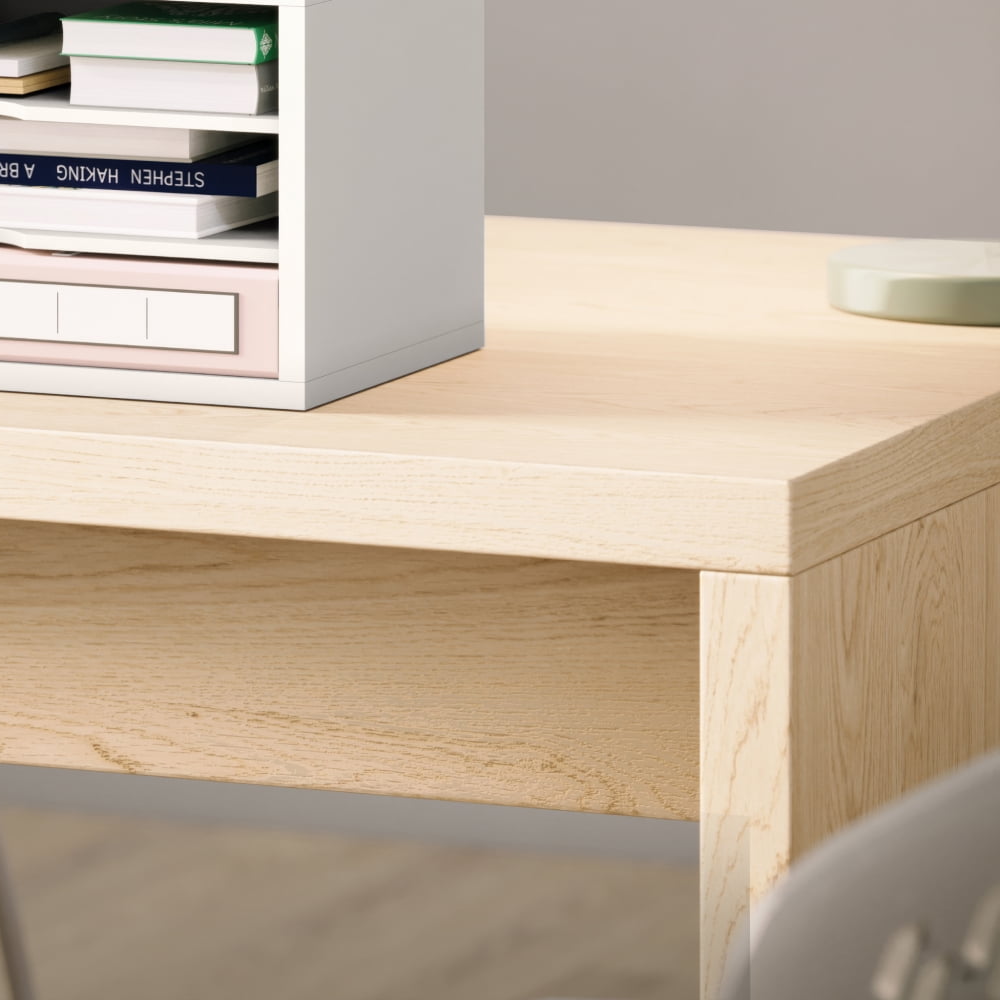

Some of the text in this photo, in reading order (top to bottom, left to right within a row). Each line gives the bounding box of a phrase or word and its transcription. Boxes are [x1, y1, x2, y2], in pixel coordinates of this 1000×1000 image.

[24, 163, 35, 179] A
[56, 164, 118, 184] HAKING
[131, 169, 205, 188] STEPHEN
